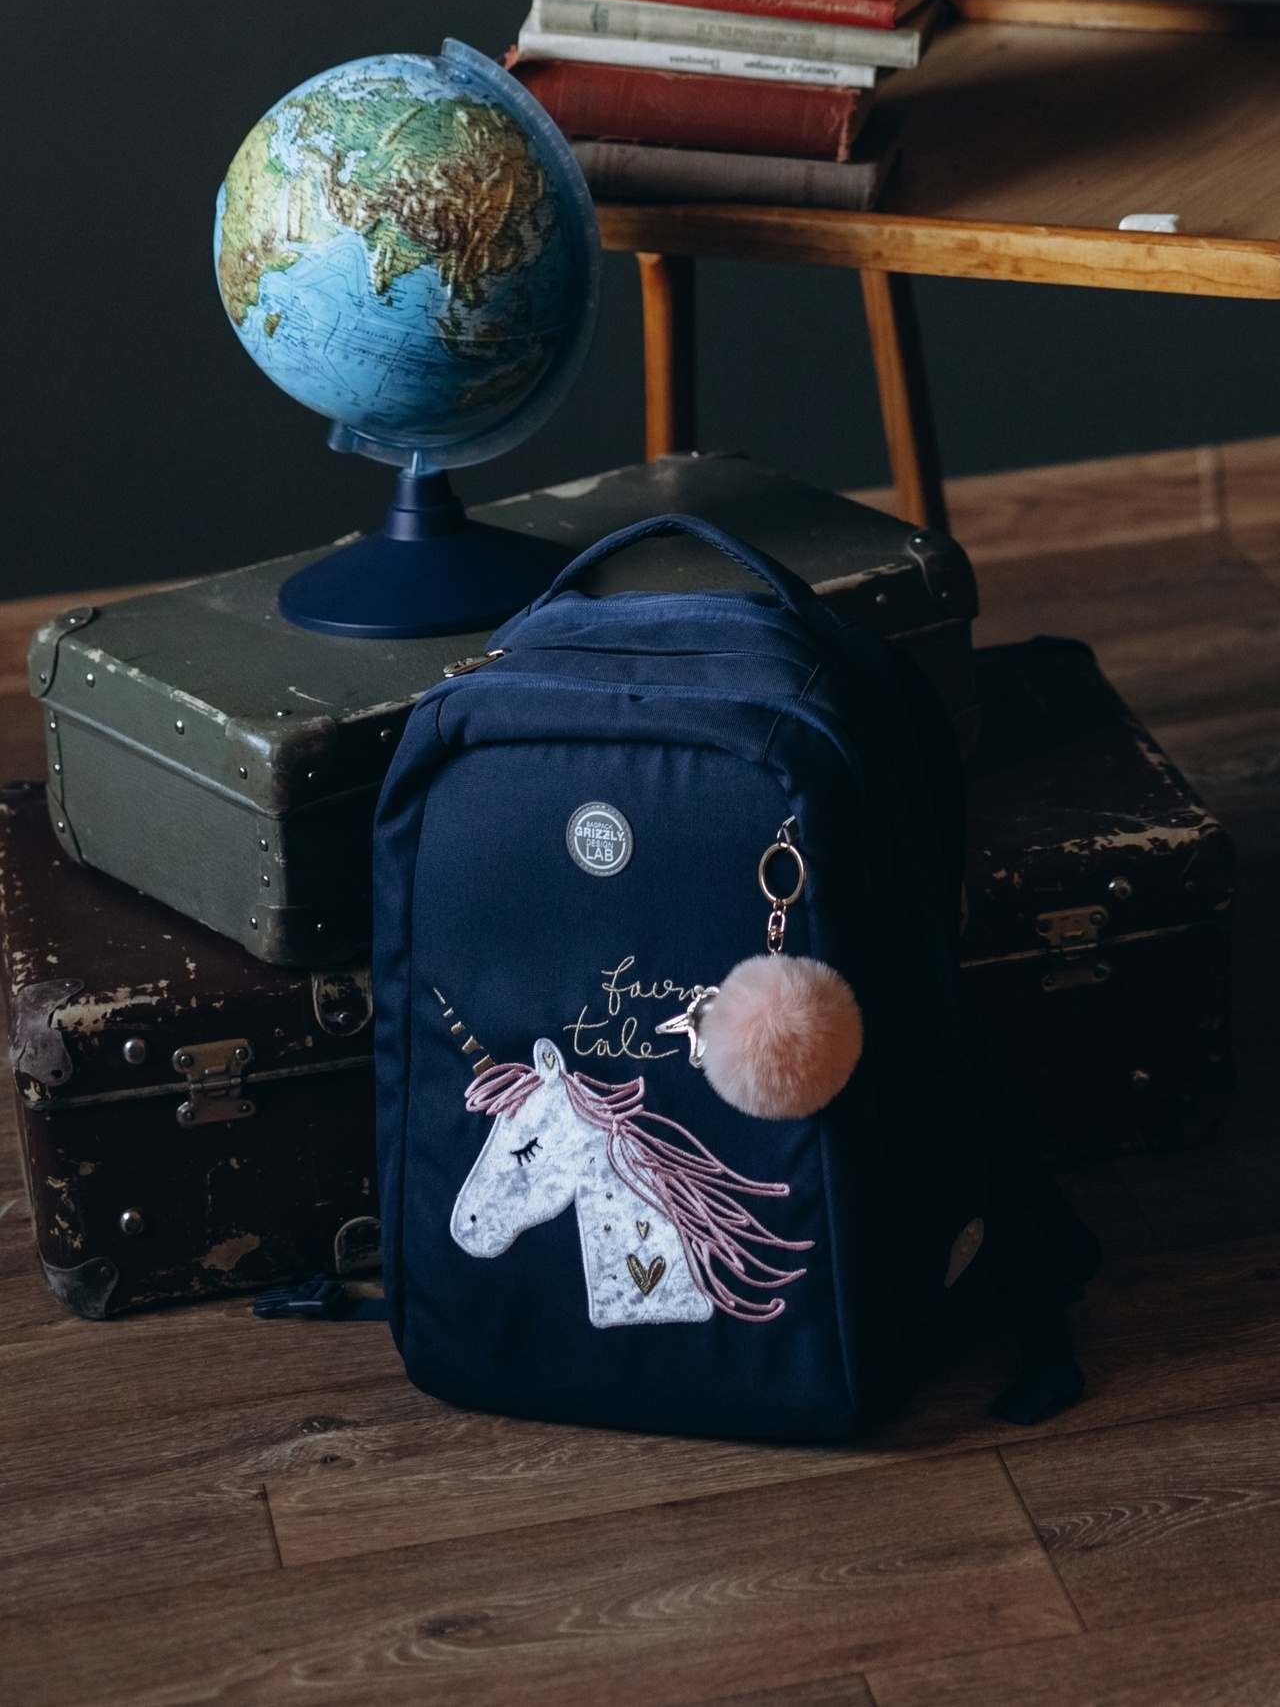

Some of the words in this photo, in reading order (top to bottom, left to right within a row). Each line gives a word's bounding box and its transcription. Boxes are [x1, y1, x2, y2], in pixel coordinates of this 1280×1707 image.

[586, 821, 613, 830] BAGPACK
[586, 839, 614, 849] DESIGN
[586, 846, 614, 862] LAB
[562, 1005, 680, 1059] tale
